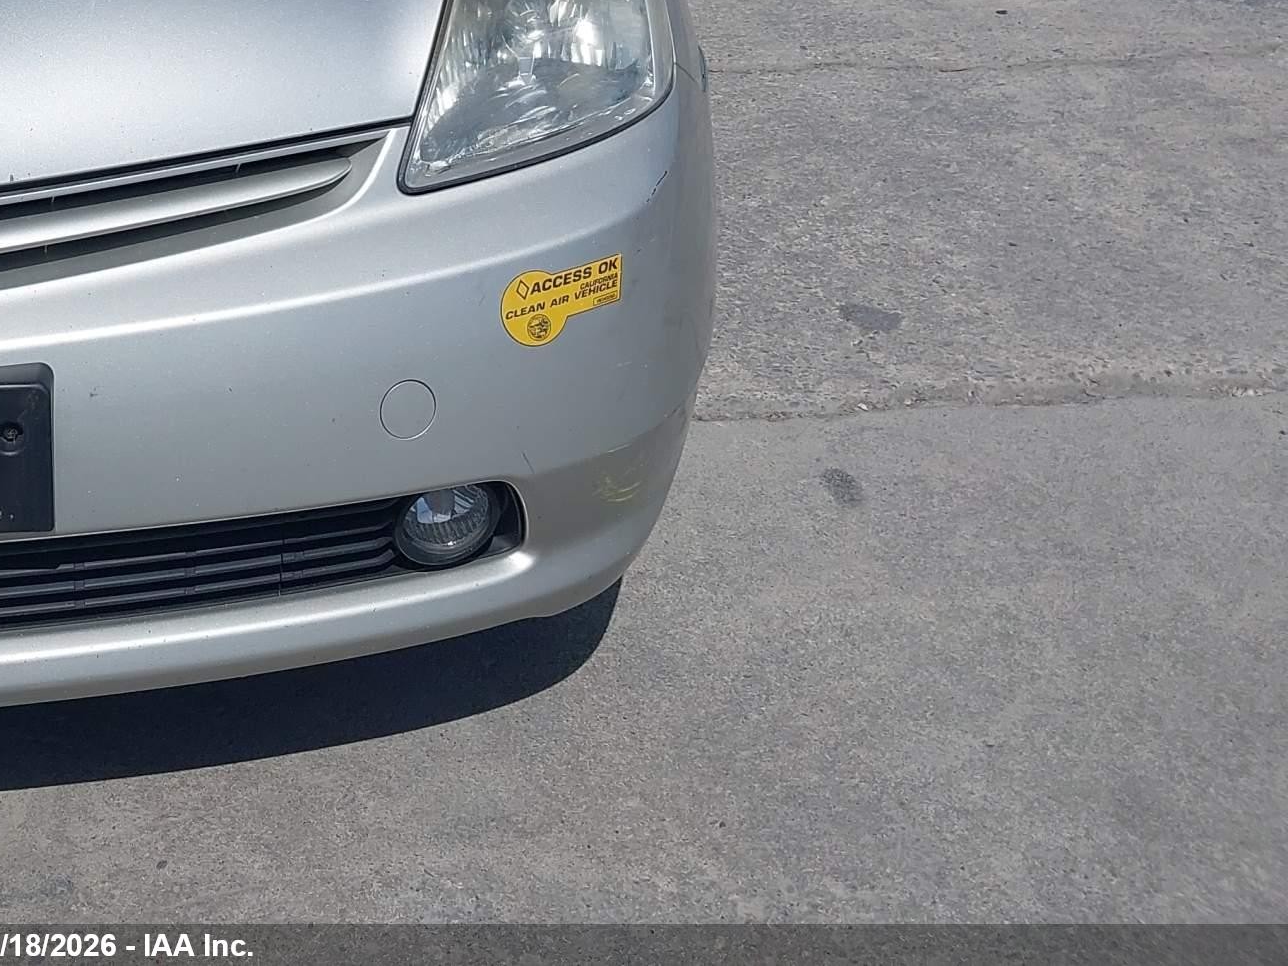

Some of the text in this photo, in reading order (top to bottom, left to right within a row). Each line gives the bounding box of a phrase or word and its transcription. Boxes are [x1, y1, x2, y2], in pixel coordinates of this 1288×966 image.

[530, 257, 618, 295] ACCESS OK
[580, 273, 618, 290] CALIFORNIA
[505, 301, 545, 320] CLEAN
[550, 295, 569, 308] AIR
[574, 279, 618, 300] VEHICLE
